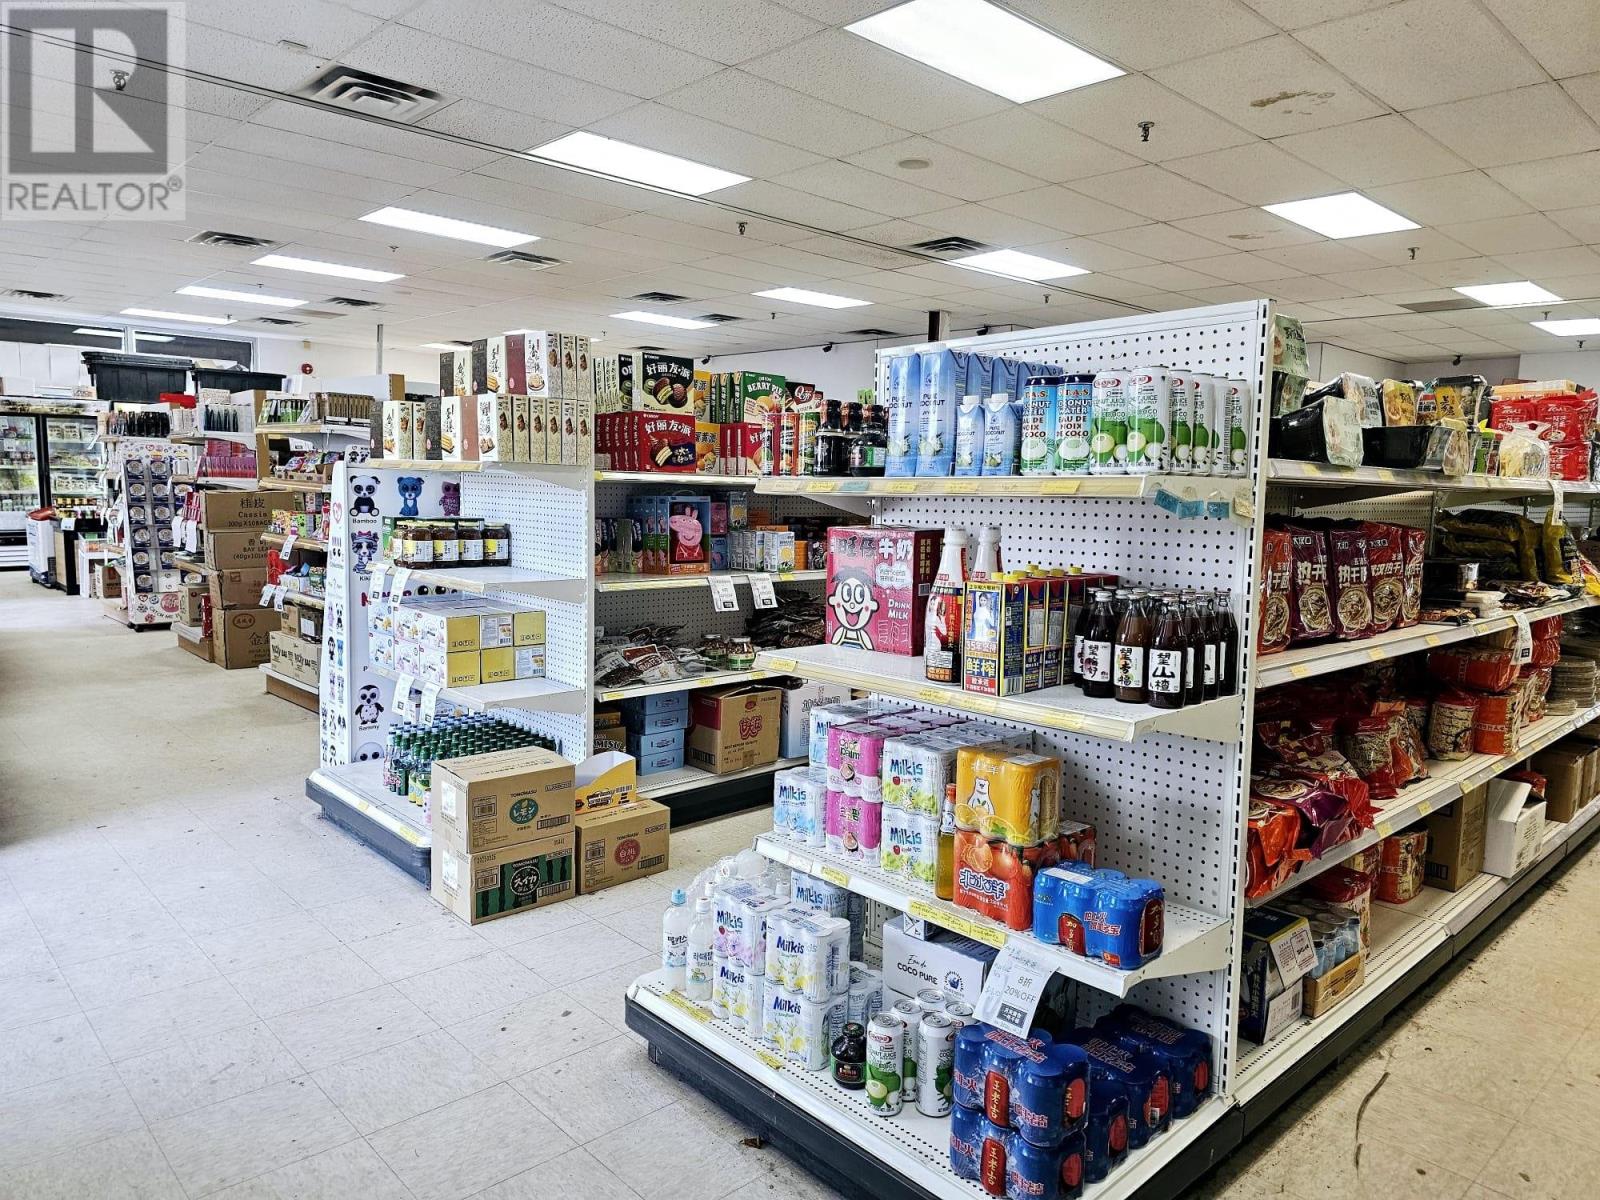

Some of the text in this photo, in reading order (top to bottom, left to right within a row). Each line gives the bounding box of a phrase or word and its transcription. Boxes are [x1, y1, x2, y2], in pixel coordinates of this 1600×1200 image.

[747, 382, 771, 393] BERRY
[241, 497, 265, 508] 桂皮
[889, 758, 924, 776] Milkis
[779, 785, 807, 801] Milkis
[889, 827, 923, 845] Milkis
[514, 874, 537, 888] スイカ
[959, 867, 1007, 899] 北冰洋
[717, 910, 743, 929] Milkis
[776, 935, 804, 954] Milkis
[720, 966, 745, 984] Milkis
[897, 962, 939, 986] COCO PURE
[773, 996, 801, 1014] Milkis
